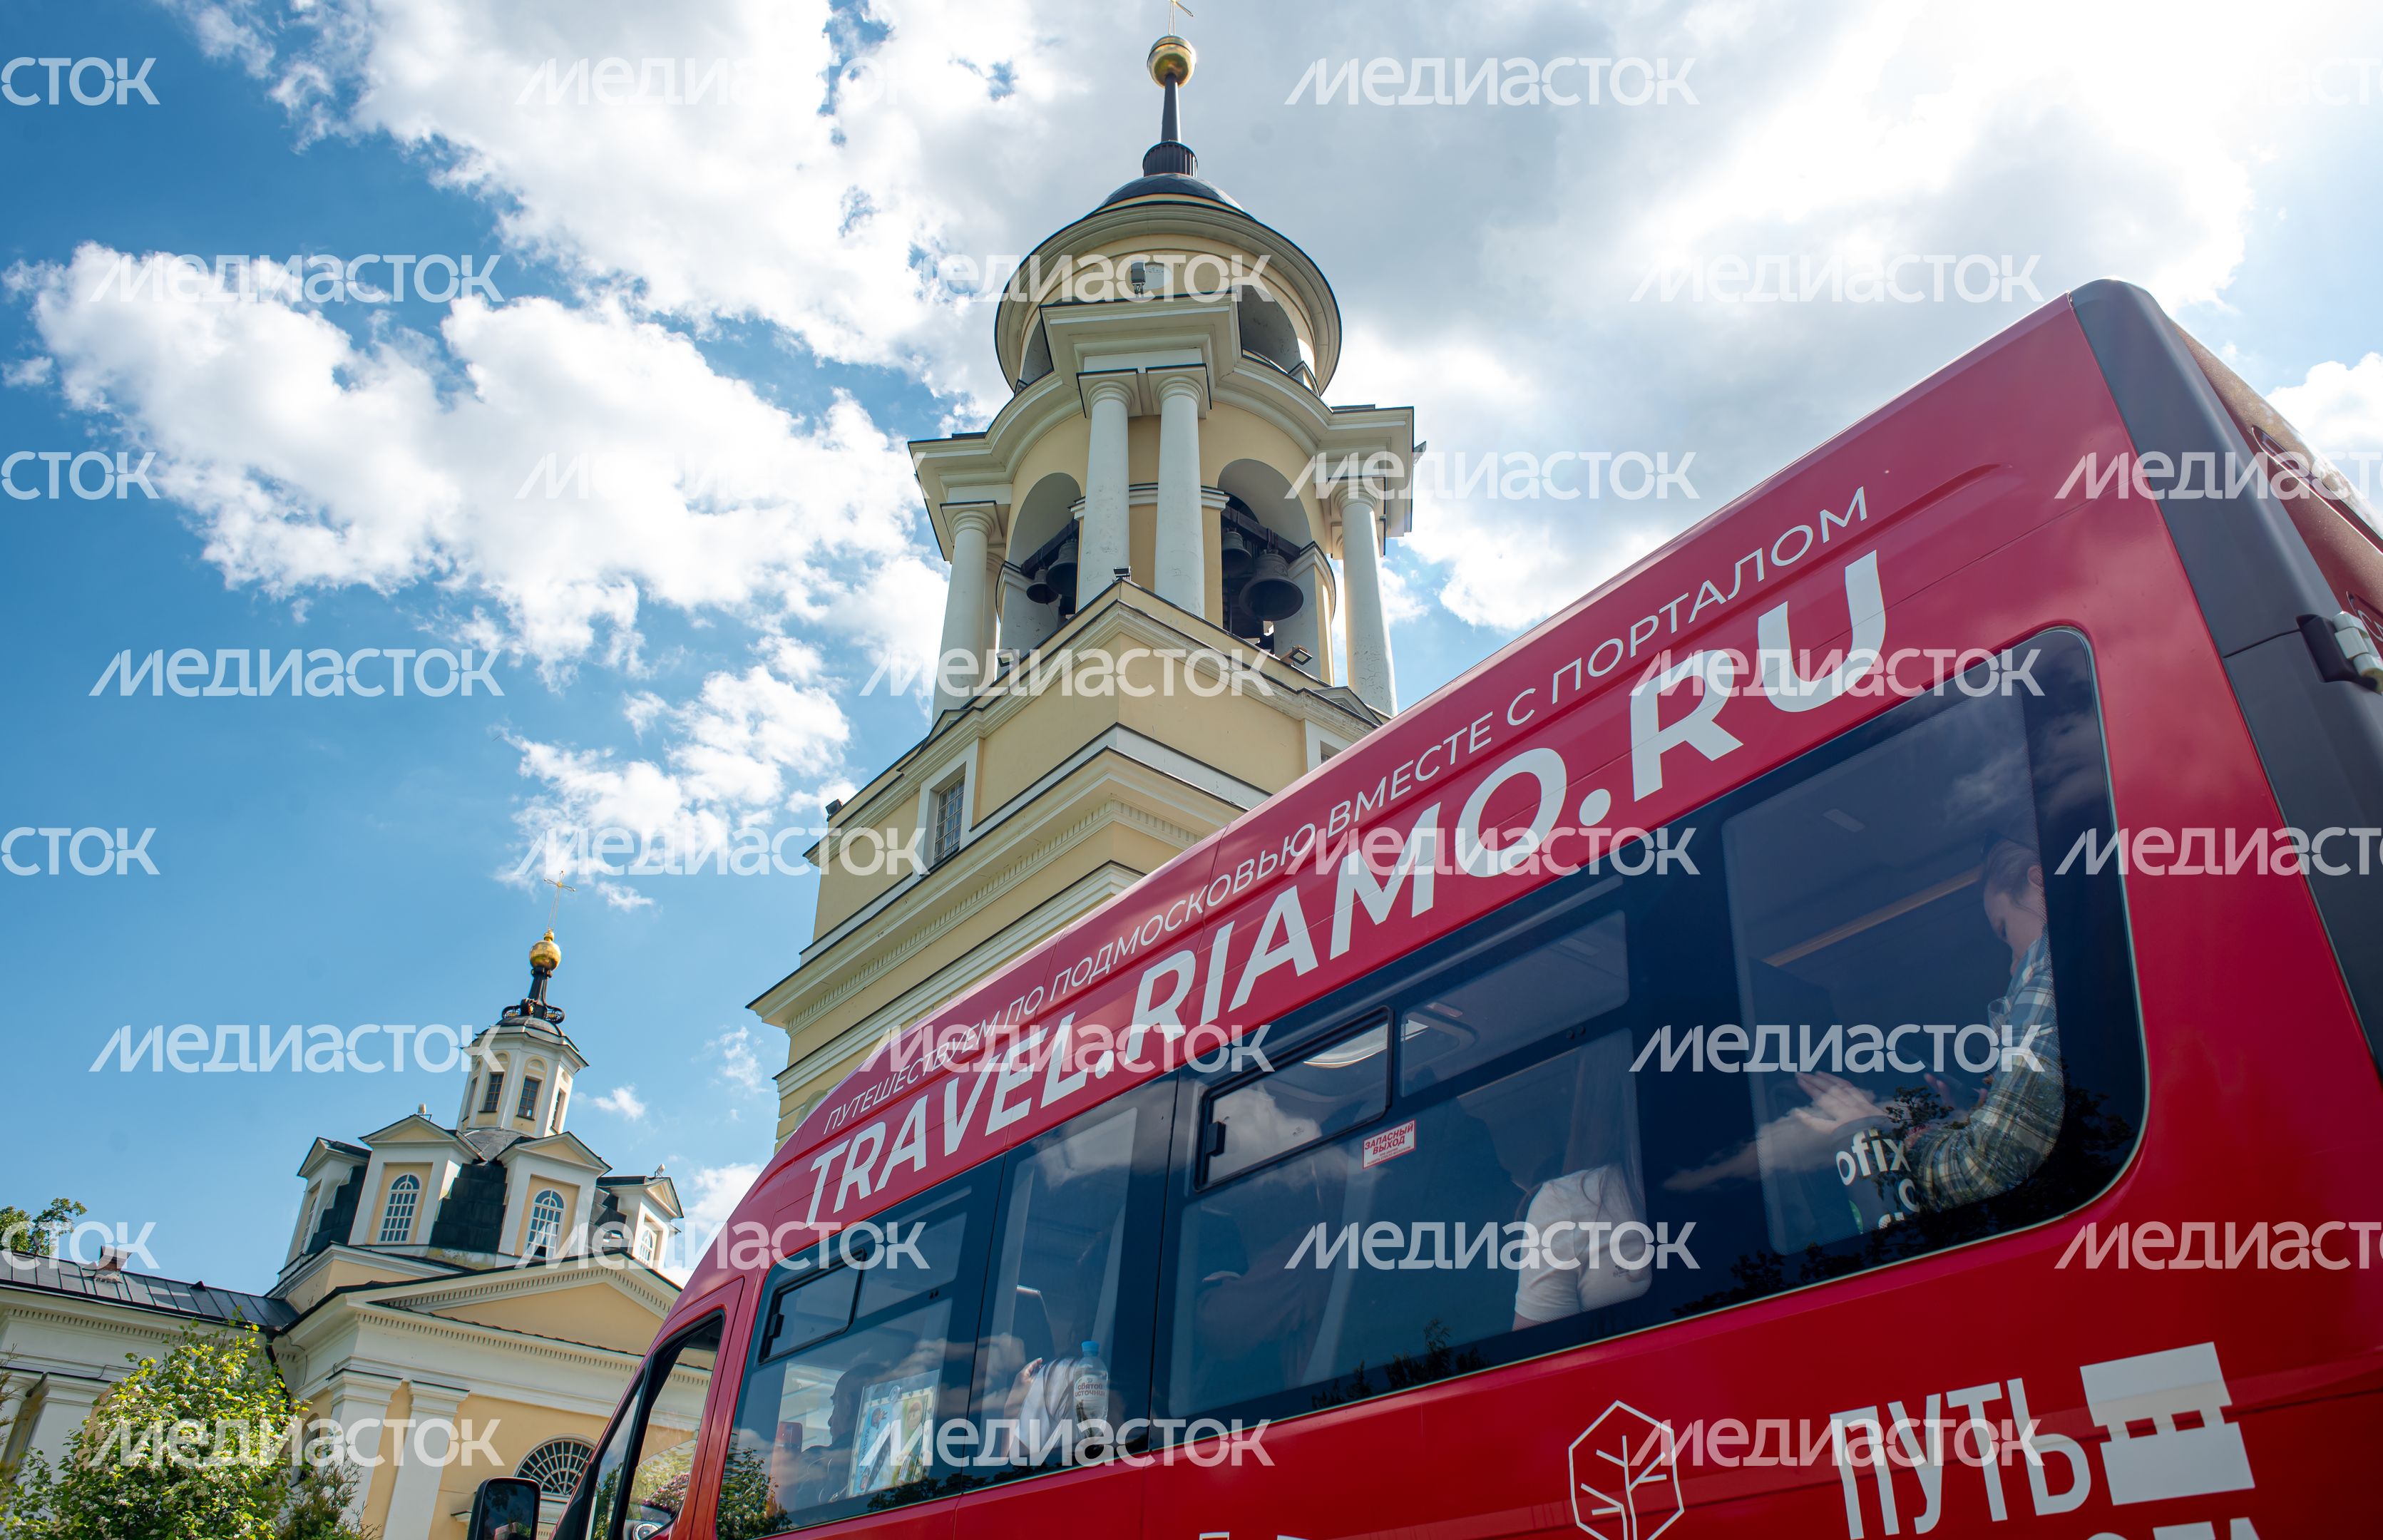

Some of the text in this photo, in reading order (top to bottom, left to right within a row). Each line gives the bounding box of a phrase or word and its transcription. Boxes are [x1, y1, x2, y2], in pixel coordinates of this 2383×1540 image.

[806, 549, 1887, 1228] TRAVEL.RIAMO.RU
[824, 486, 1867, 1134] ПУТЕШЕСТВУЕМ ПО ПОДМОСКОВЬЮ ВМЕСТЕ С ПОРТАЛОМ
[1365, 1122, 1413, 1150] ЗАПАСНЫЙ
[1373, 1135, 1405, 1155] ВЫХОД
[1830, 1377, 2091, 1540] ПУТЬ
